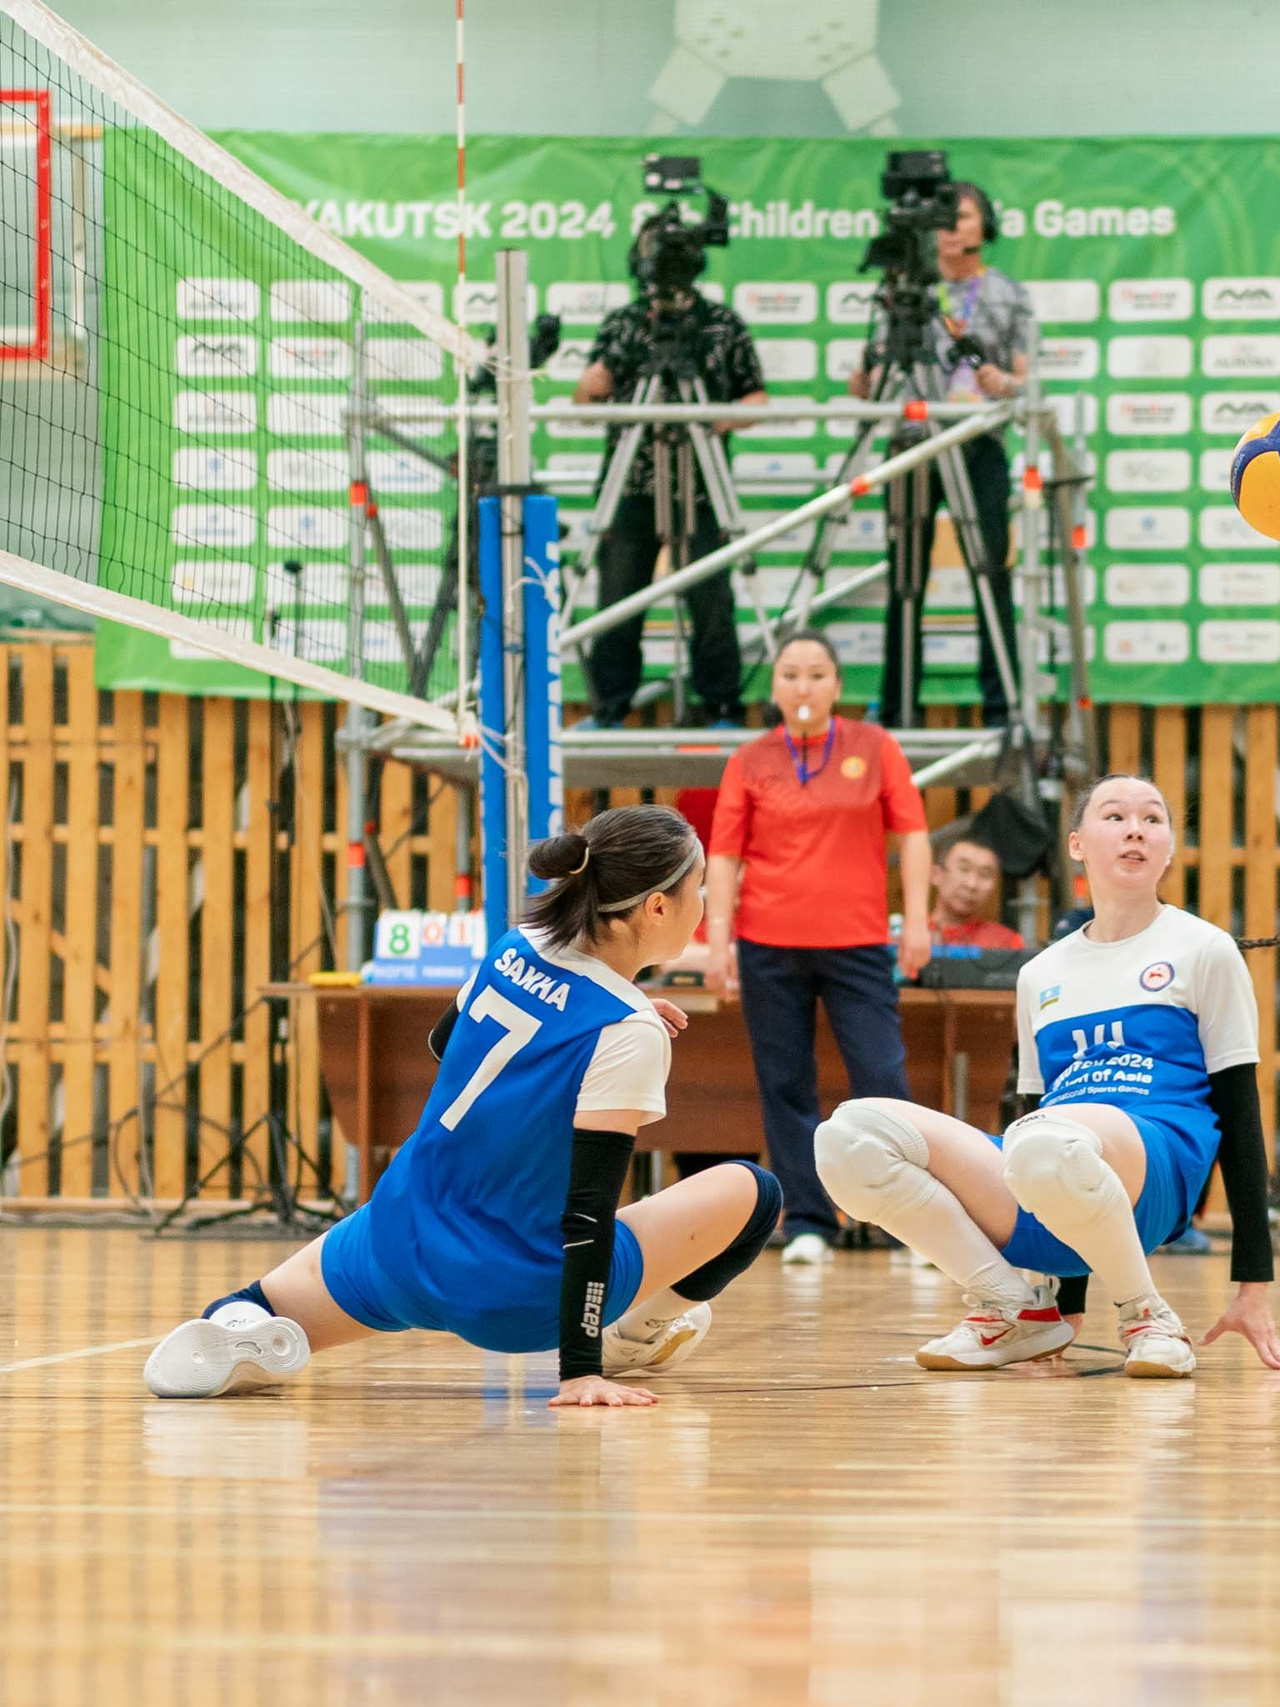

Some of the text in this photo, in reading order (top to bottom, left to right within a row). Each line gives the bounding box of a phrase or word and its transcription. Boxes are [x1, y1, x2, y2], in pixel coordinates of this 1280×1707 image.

[501, 201, 616, 238] 2024
[1034, 200, 1175, 236] Games
[389, 923, 410, 955] 8
[494, 948, 571, 1012] SAKHA
[439, 984, 543, 1131] 7
[1113, 1070, 1152, 1084] Asia
